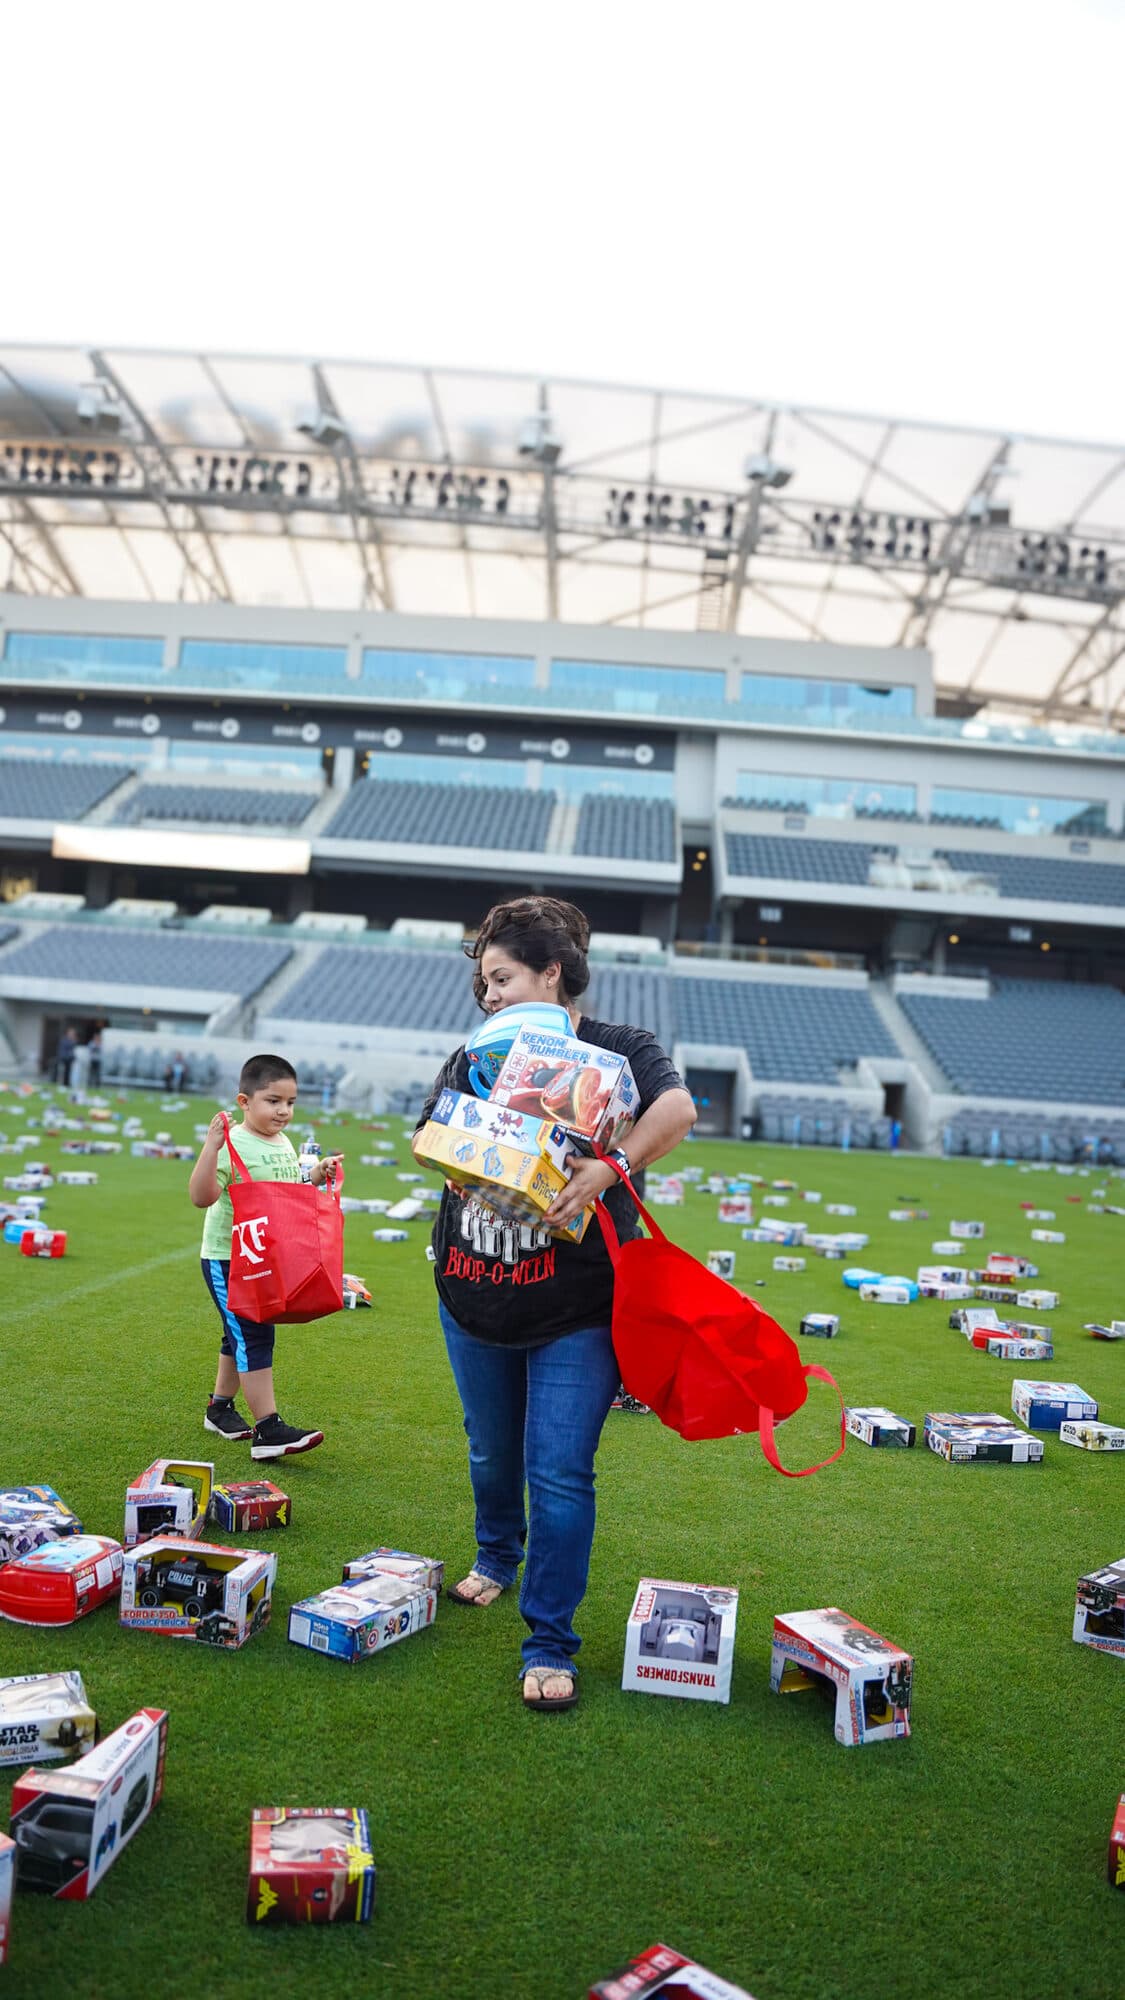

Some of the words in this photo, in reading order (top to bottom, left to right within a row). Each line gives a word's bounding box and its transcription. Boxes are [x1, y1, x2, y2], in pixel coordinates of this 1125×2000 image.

[521, 1032, 568, 1048] VENOM
[528, 1044, 591, 1061] TUMBLER
[272, 1167, 298, 1179] THIS
[168, 1570, 196, 1586] POLICE
[123, 1609, 149, 1619] FORD
[636, 1665, 716, 1688] TRANSFORMERS
